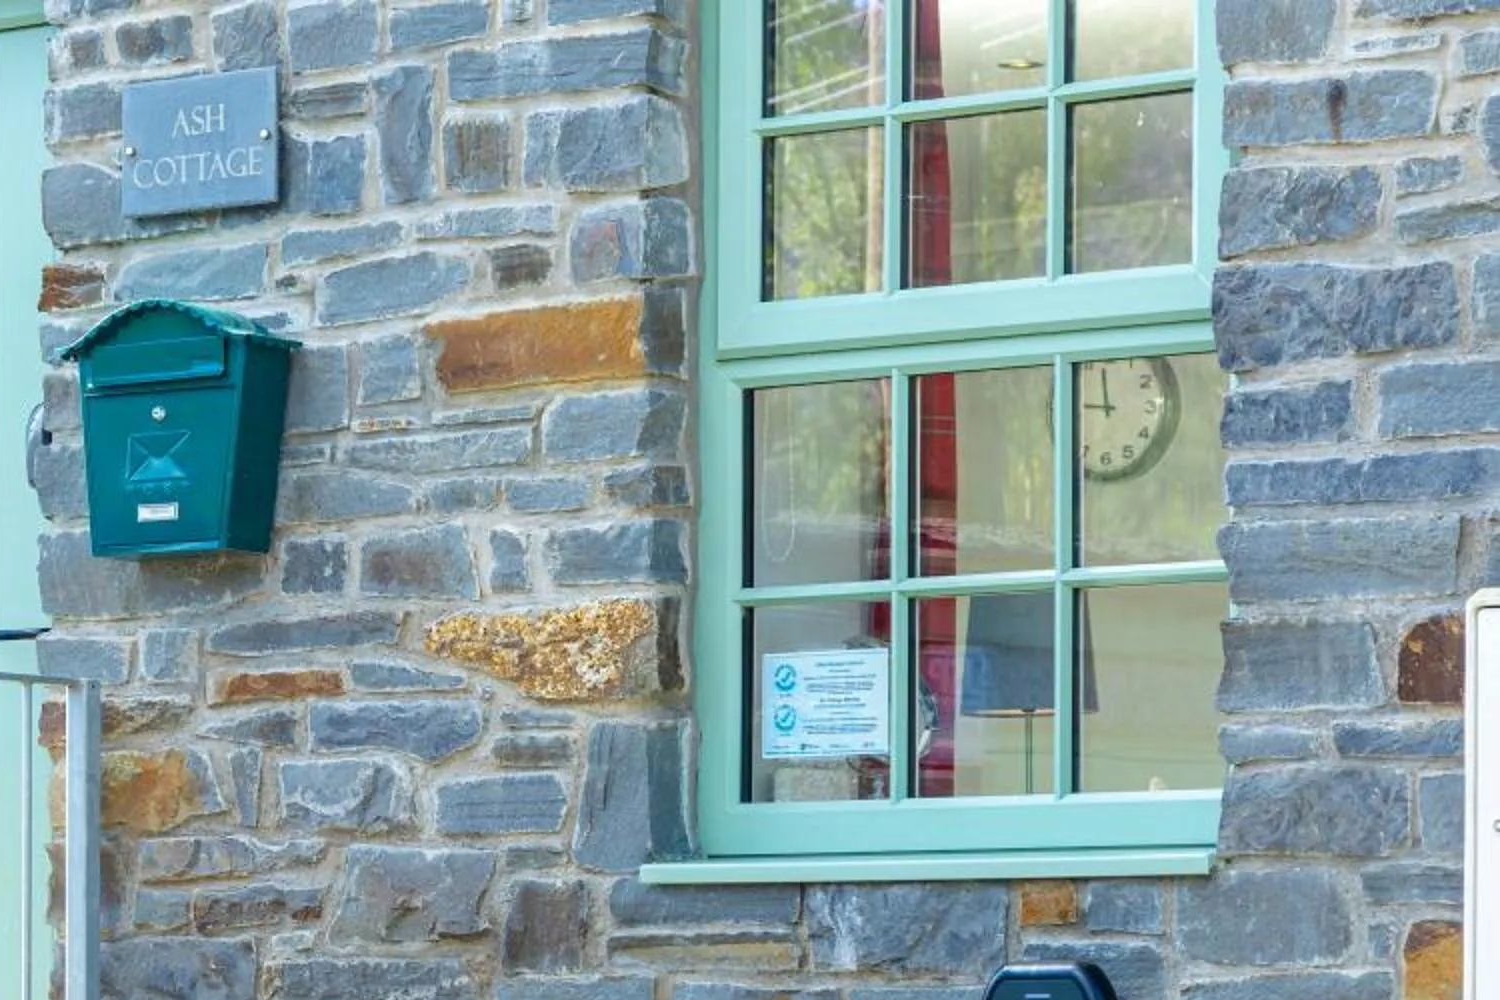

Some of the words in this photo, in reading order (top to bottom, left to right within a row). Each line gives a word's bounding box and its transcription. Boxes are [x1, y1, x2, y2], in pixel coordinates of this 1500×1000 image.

[171, 103, 226, 138] ASH
[133, 146, 264, 189] COTTAGE
[1139, 374, 1152, 389] 2
[1144, 400, 1156, 414] 3
[1138, 426, 1149, 439] 4
[1100, 452, 1112, 465] 6
[1122, 445, 1134, 459] 5
